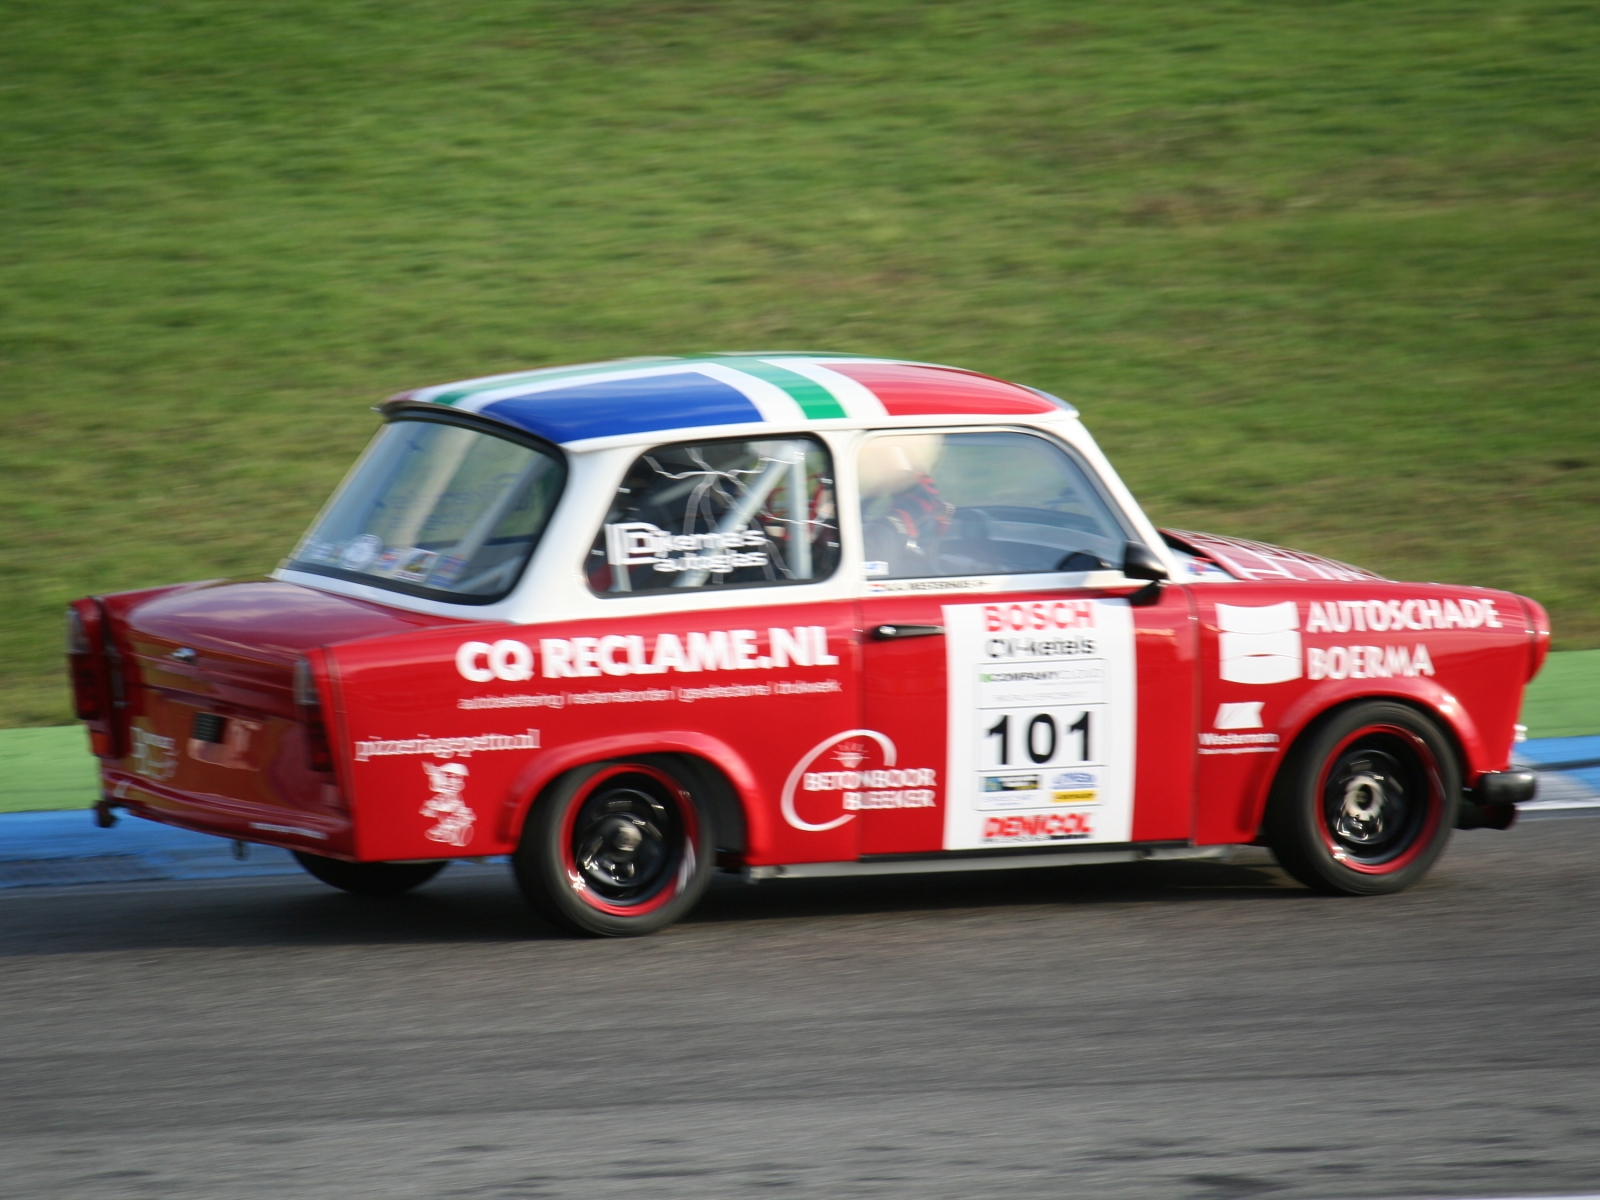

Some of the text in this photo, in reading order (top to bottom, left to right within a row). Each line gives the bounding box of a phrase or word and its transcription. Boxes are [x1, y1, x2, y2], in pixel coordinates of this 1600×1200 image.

[982, 601, 1097, 632] BOSCH
[1305, 598, 1503, 634] AUTOSCHADE
[455, 625, 840, 683] CQ RECLAME.NL
[1306, 643, 1436, 681] BOERMA
[983, 710, 1094, 766] 101
[803, 768, 937, 791] BETONBOOR
[843, 789, 936, 810] BLEEKER
